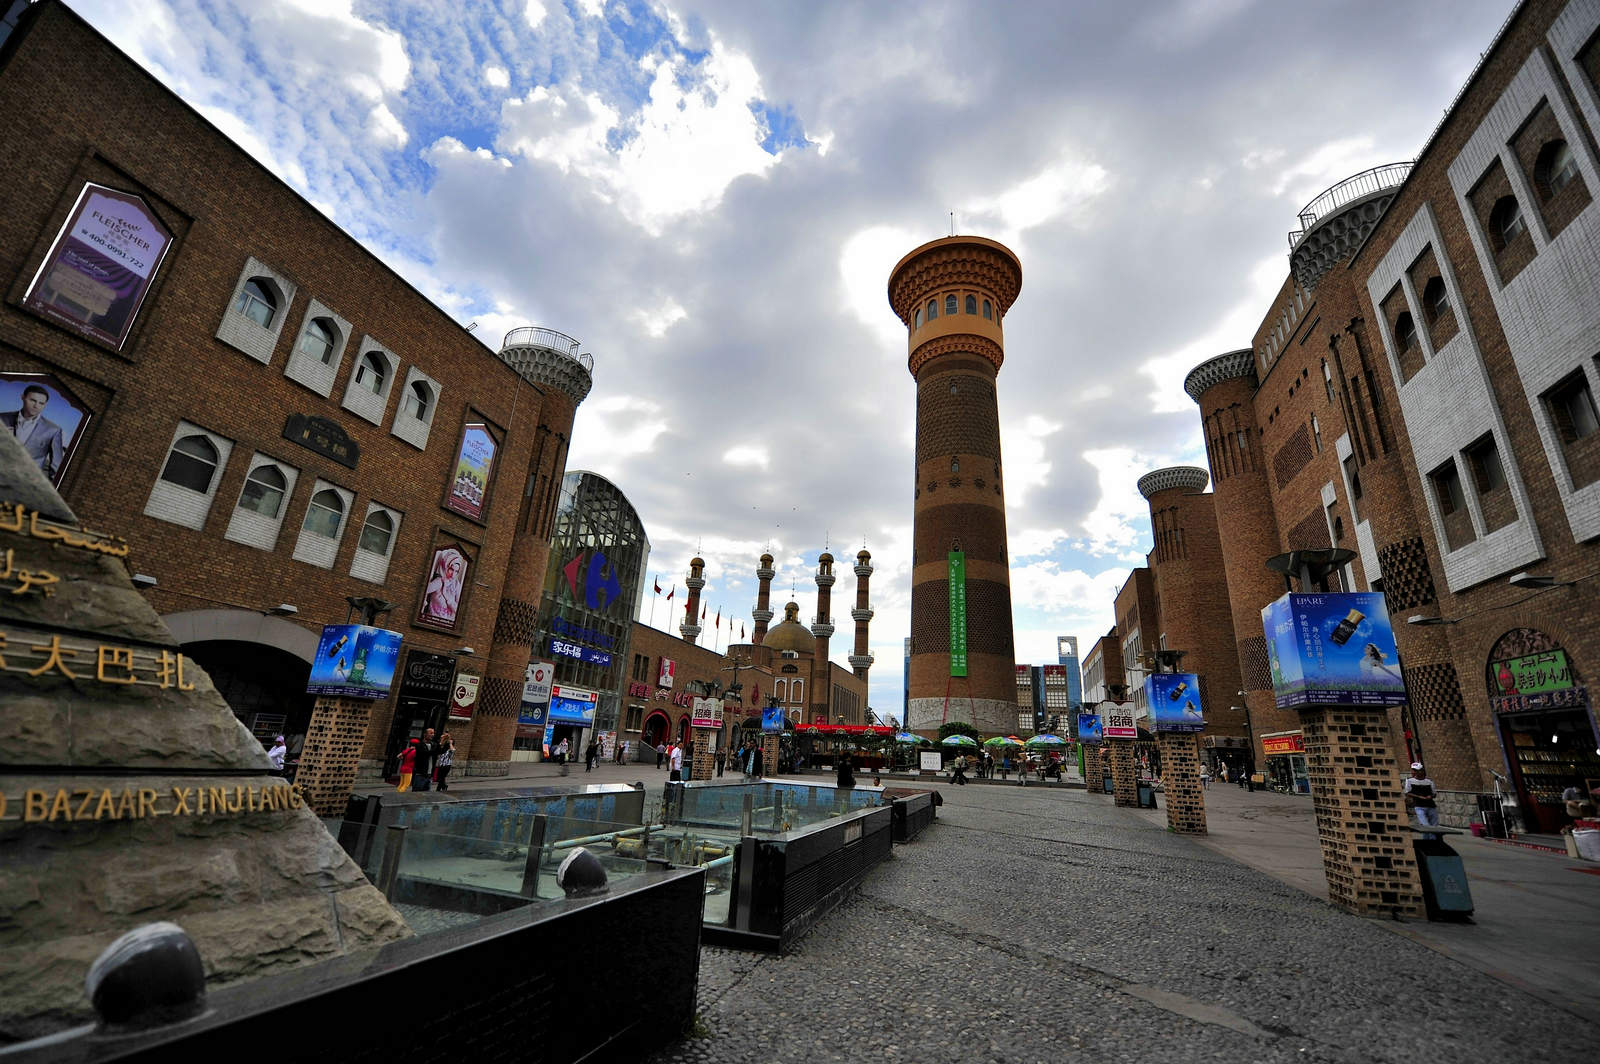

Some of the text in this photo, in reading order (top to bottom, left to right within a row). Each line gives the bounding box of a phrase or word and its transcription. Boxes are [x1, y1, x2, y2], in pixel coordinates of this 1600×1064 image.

[92, 210, 150, 251] FLEISCHER
[0, 632, 195, 691] 大巴扎
[553, 641, 582, 658] 家乐福
[673, 691, 694, 708] KFC
[1109, 715, 1133, 727] 招商
[24, 788, 157, 822] BAZAAR
[173, 784, 305, 817] XINJIANG
